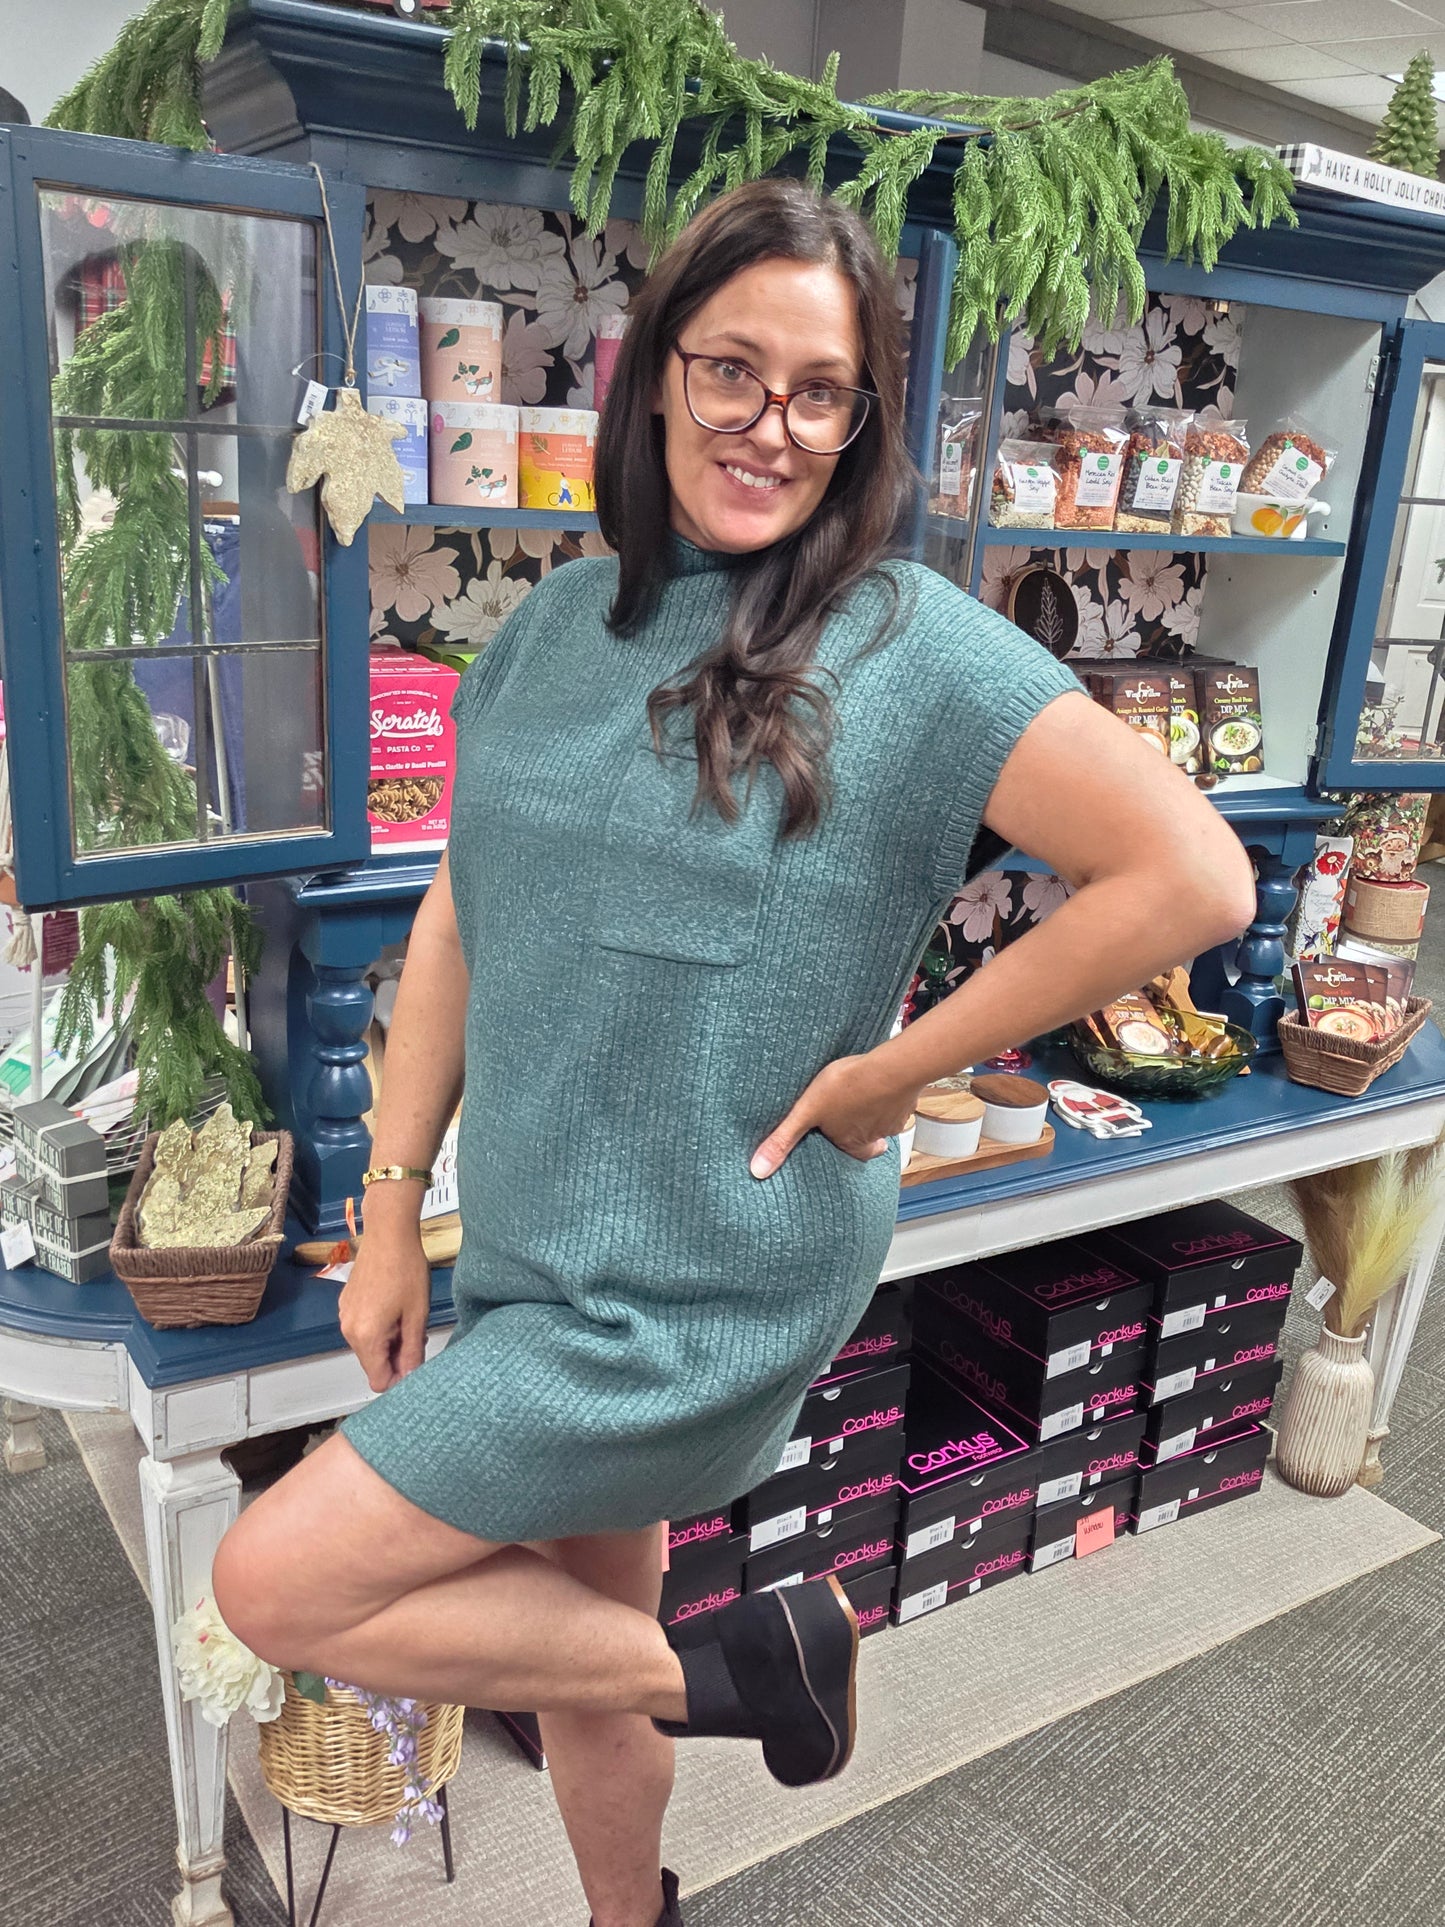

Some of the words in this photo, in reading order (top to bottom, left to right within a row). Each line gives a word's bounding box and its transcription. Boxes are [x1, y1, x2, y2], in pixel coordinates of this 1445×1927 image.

[1325, 159, 1350, 183] HAVE
[1354, 169, 1360, 185] A
[1364, 171, 1392, 194] HOLLY
[1395, 181, 1421, 202] JOLLY
[1116, 707, 1132, 715] Asiago
[1128, 715, 1142, 725] DIP
[1143, 715, 1158, 724] MIX
[1171, 705, 1185, 713] MIX
[1220, 705, 1234, 714] DIP
[1234, 704, 1248, 713] MIX
[370, 708, 443, 739] Scratch
[1323, 996, 1337, 1005] DIP
[1338, 996, 1355, 1005] MIX
[3, 1190, 15, 1215] THE
[54, 1214, 63, 1236] OF
[64, 1219, 70, 1240] A
[1171, 1231, 1254, 1254] Corkys
[48, 1252, 73, 1279] ERASED
[1034, 1268, 1115, 1297] Corkys
[1246, 1282, 1289, 1301] Corkys
[1098, 1322, 1142, 1344] Corkys
[841, 1334, 892, 1357] orkys
[1233, 1343, 1274, 1363] Corkys
[1089, 1384, 1135, 1407] Corkys
[1232, 1397, 1271, 1419] Corkys
[842, 1406, 899, 1434] Corkys
[908, 1431, 996, 1471] Corkys
[1088, 1451, 1135, 1472] Corkys
[838, 1473, 893, 1501] Corkys
[1220, 1469, 1260, 1491] Corkys
[982, 1488, 1030, 1514] Corkys
[833, 1539, 888, 1567] Corkys
[974, 1550, 1022, 1576] Corkys
[676, 1587, 735, 1619] Corkys
